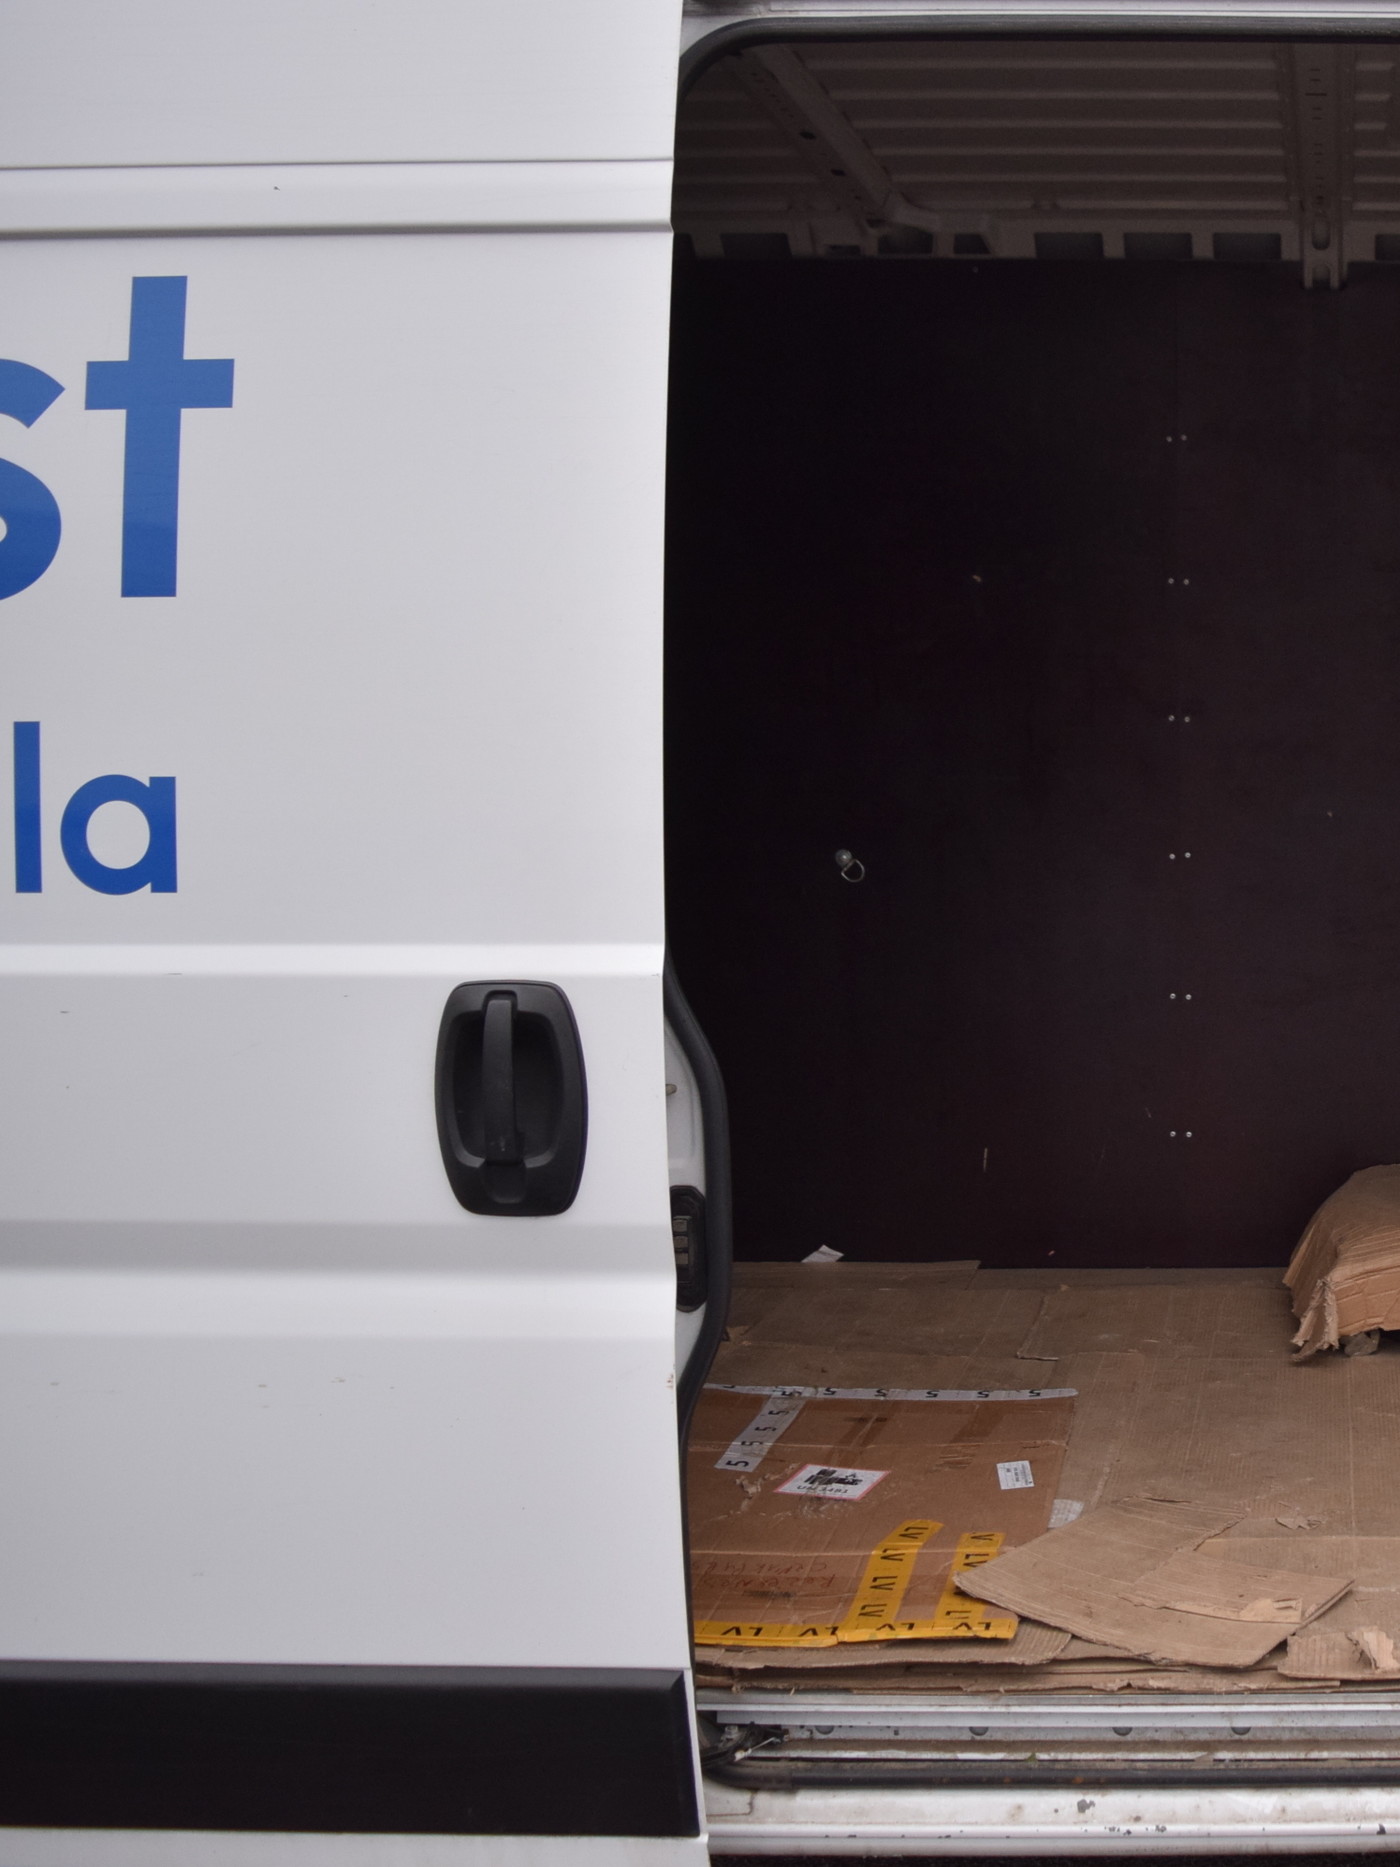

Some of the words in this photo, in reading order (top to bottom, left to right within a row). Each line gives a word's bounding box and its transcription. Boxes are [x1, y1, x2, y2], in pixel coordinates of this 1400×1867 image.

[13, 720, 178, 895] la
[898, 1526, 930, 1540] LV
[880, 1548, 907, 1562] LV
[869, 1575, 898, 1591] LV
[857, 1603, 888, 1618] LV
[720, 1626, 764, 1637] LV
[798, 1626, 840, 1636] LV
